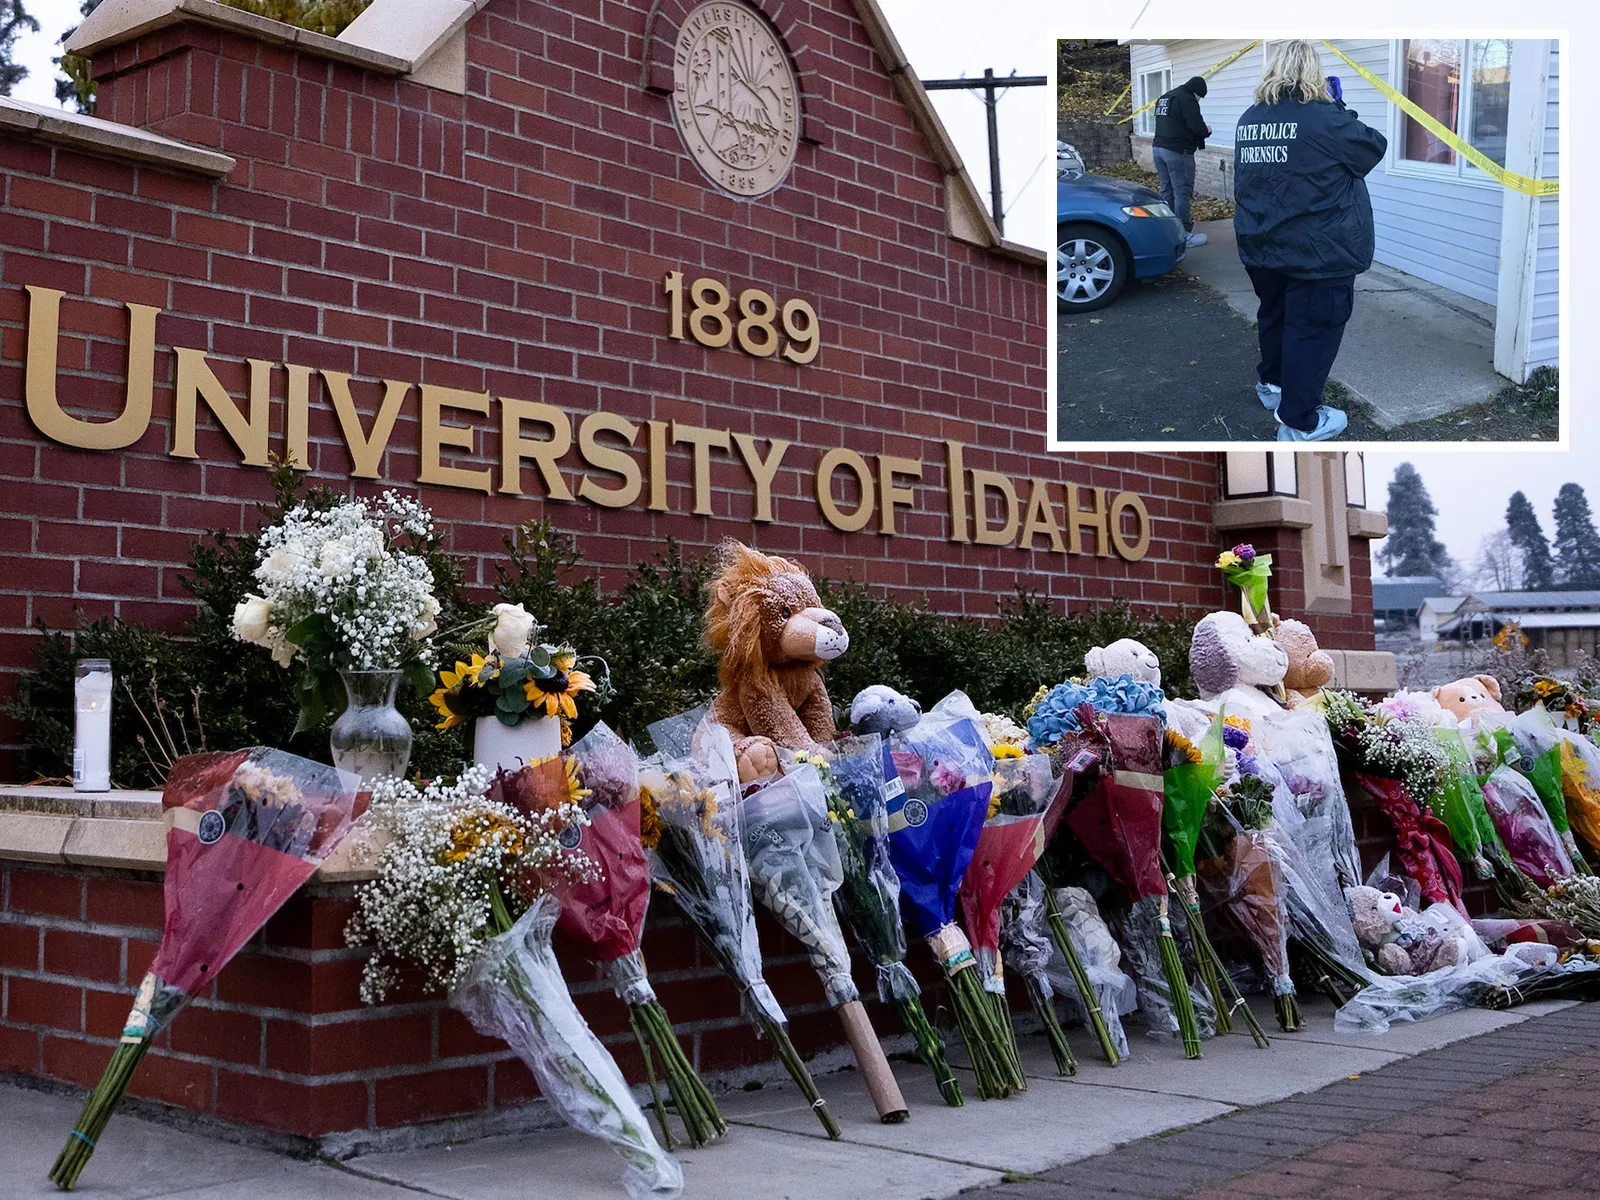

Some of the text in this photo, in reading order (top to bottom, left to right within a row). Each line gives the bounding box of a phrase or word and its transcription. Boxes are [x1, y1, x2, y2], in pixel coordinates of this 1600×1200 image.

[675, 7, 761, 67] UNIVERSITY
[766, 43, 784, 70] OF
[779, 85, 793, 158] IDAHO
[1236, 122, 1298, 142] STATE POLICE
[1240, 145, 1288, 164] FORENSICS
[664, 270, 821, 364] 1889
[23, 284, 1151, 562] UNIVERSITY OF IDAHO
